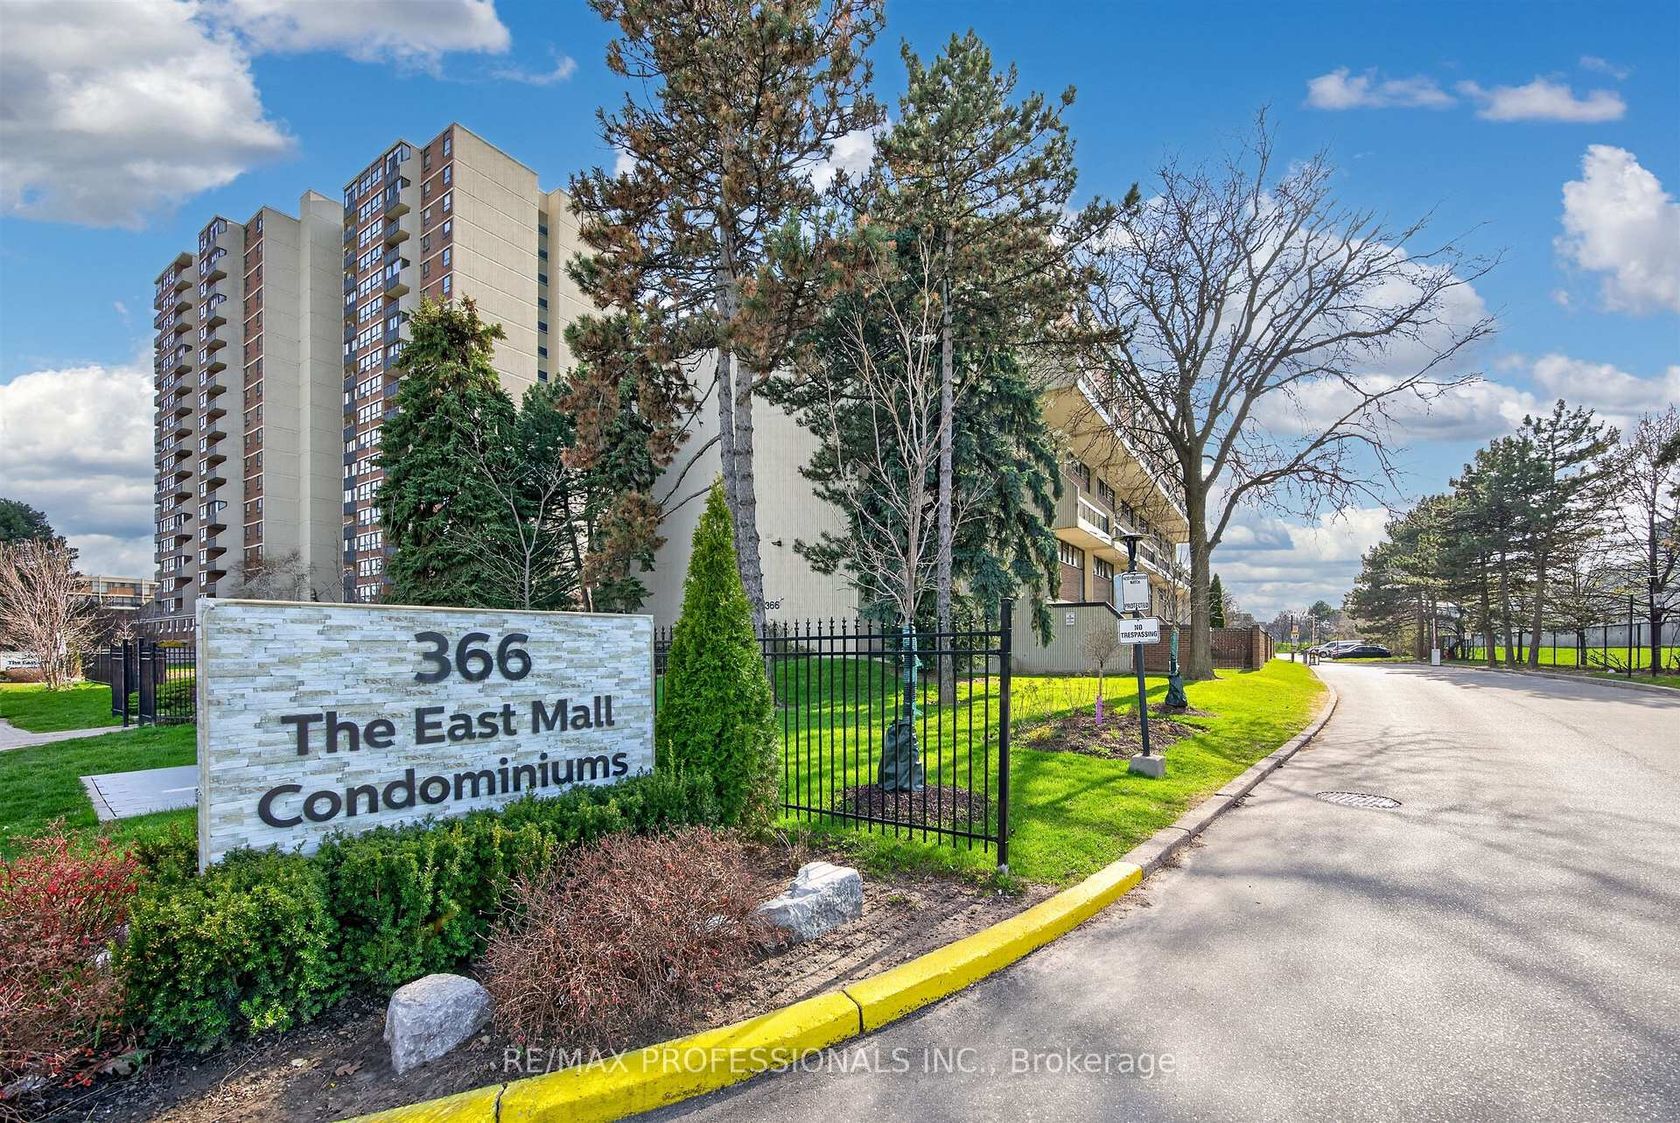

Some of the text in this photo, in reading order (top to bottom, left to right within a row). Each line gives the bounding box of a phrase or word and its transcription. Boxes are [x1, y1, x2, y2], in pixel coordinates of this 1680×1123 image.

[765, 601, 780, 610] 366
[414, 631, 532, 684] 366
[281, 694, 615, 756] The East Mall
[257, 752, 628, 828] Condominiums
